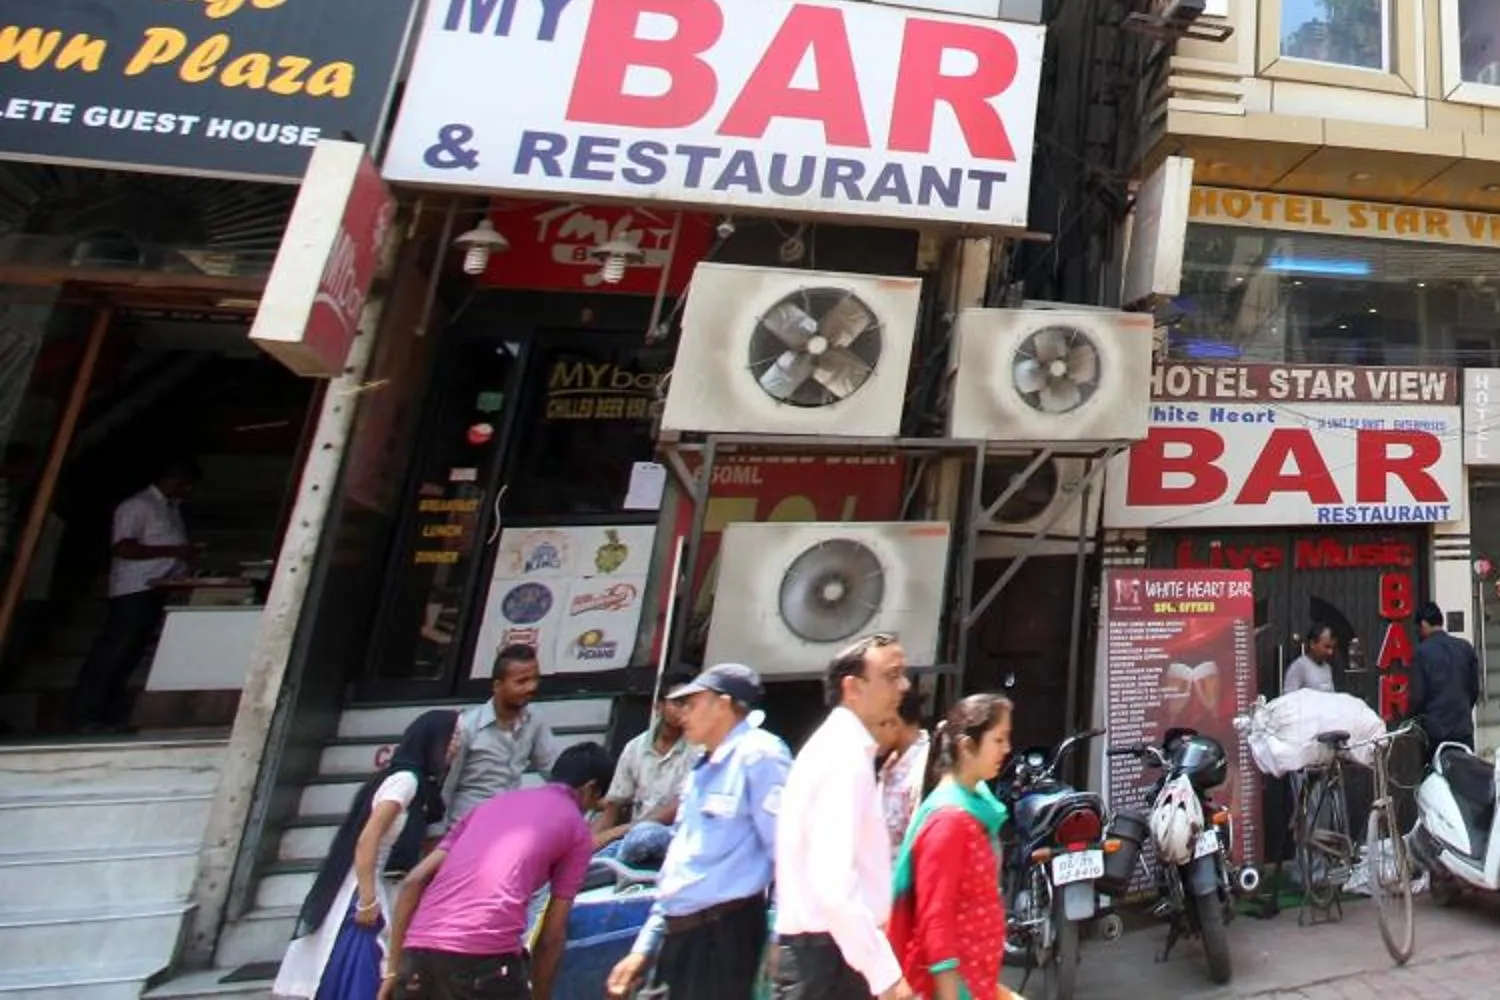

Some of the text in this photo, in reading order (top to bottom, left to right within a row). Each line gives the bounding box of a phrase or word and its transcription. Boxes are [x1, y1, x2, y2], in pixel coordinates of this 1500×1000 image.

[124, 27, 355, 98] Plaza
[82, 105, 200, 137] GUEST
[206, 118, 321, 148] HOUSE
[423, 123, 1007, 212] & RESTAURANT
[1188, 187, 1331, 226] HOTEL
[1349, 202, 1449, 237] STAR
[1149, 366, 1448, 401] HOTEL STAR VIEW
[1149, 407, 1276, 424] hite Heart
[1125, 427, 1449, 506] BAR
[1317, 505, 1450, 523] RESTAURANT
[1175, 538, 1415, 570] Live Music
[1145, 580, 1253, 598] WHITE HEART BAR
[1376, 573, 1415, 723] BAR
